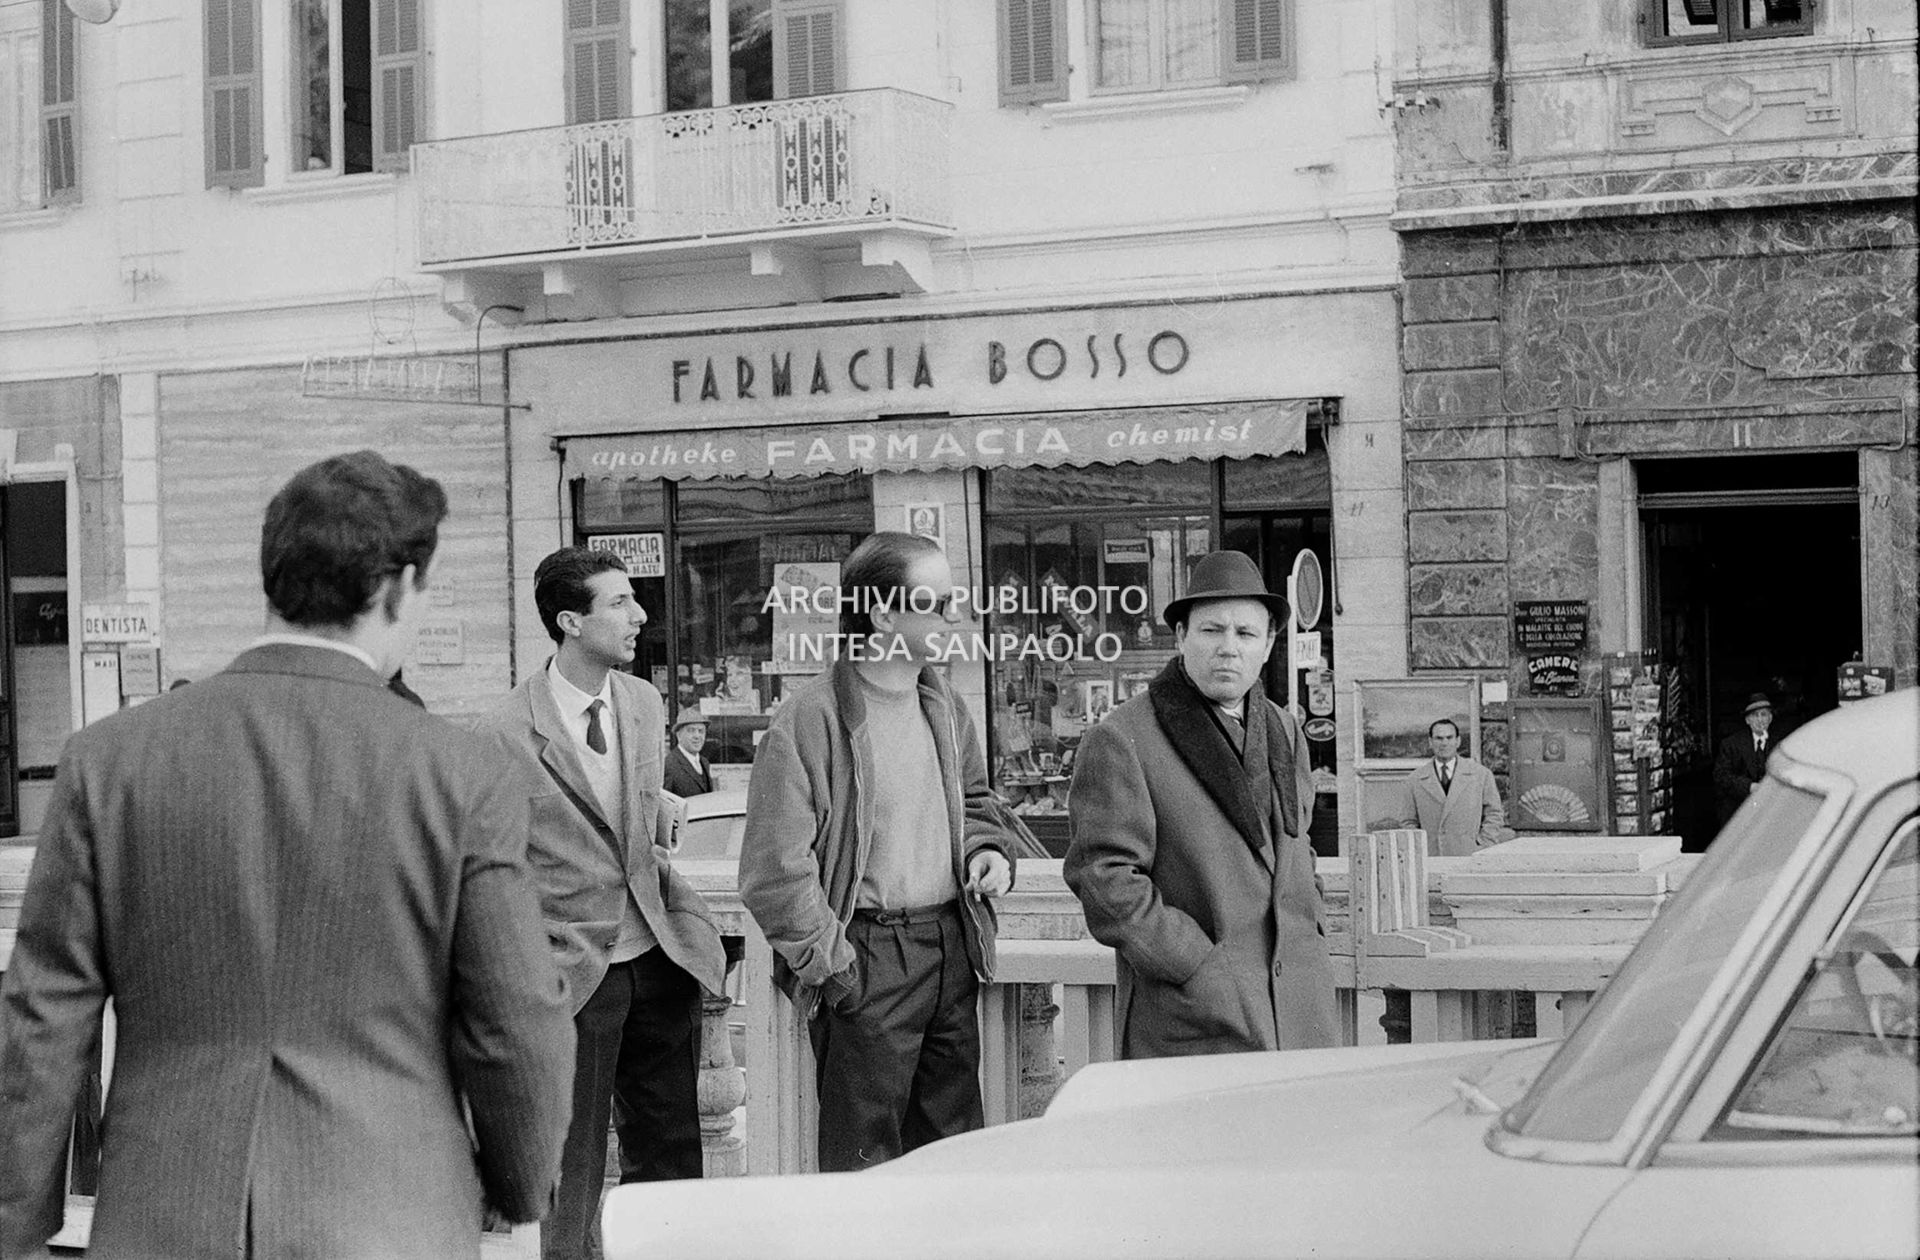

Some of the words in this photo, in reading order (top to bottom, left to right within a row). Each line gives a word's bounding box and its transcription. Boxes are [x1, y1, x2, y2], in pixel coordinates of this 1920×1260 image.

[672, 344, 935, 403] FARMACIA
[988, 330, 1190, 385] BOSSO
[592, 441, 737, 471] apotheke
[766, 427, 1071, 465] FARMACIA
[1107, 418, 1254, 448] chemist
[591, 536, 660, 555] FARMACIA
[85, 617, 148, 634] DENTISTA
[1528, 655, 1579, 674] CAMERE
